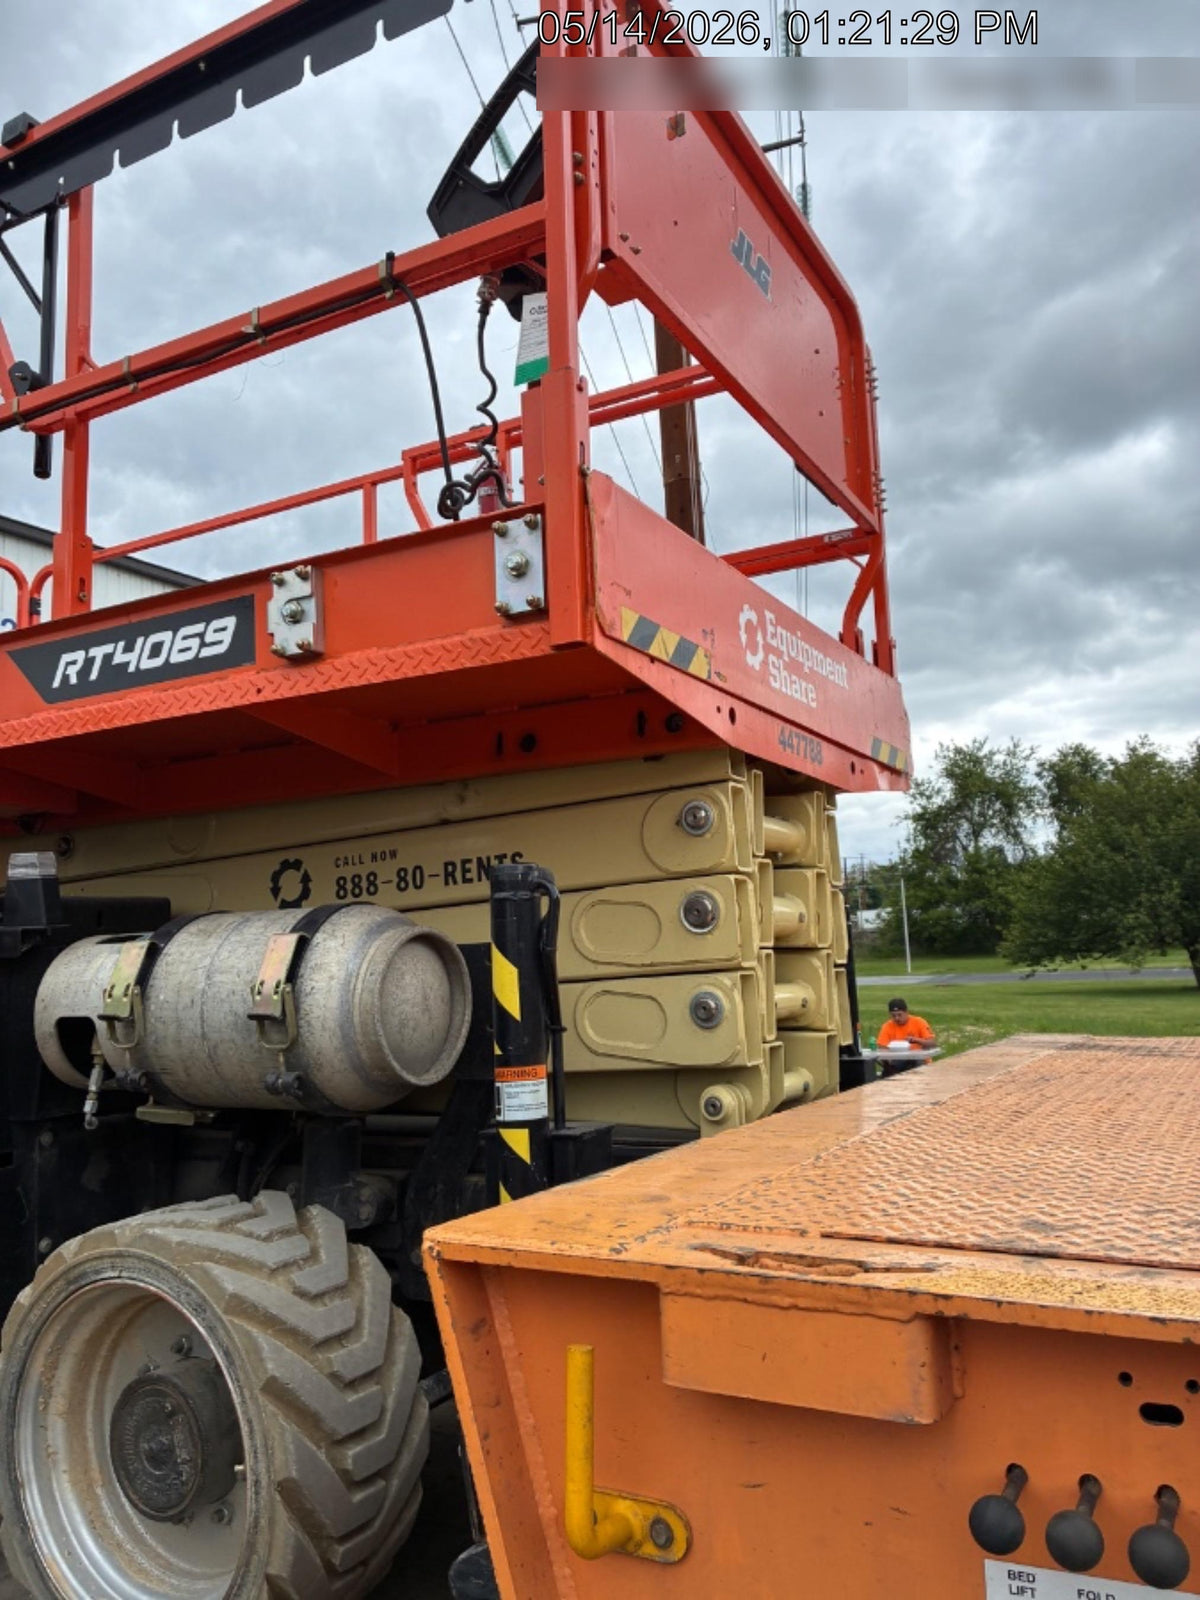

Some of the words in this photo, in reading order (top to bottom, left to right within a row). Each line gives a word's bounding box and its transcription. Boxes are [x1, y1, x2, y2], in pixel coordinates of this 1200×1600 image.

[730, 227, 772, 302] JLG
[52, 615, 237, 689] RT4069
[764, 609, 849, 689] Equipment
[768, 653, 817, 708] Share
[334, 855, 365, 868] CALL
[370, 849, 398, 863] NOW
[1007, 1569, 1036, 1584] BED
[1008, 1583, 1037, 1599] LIFT
